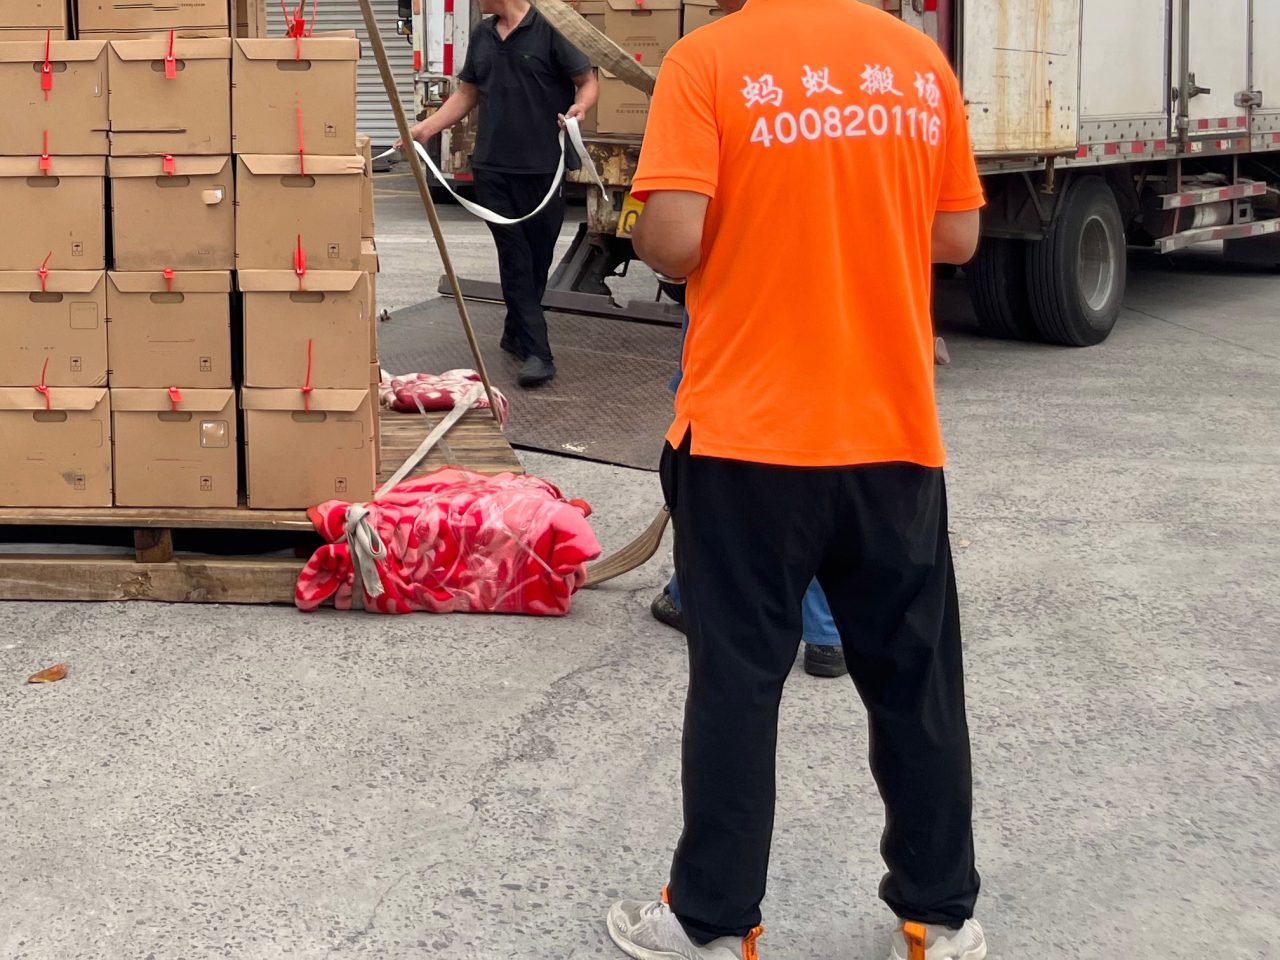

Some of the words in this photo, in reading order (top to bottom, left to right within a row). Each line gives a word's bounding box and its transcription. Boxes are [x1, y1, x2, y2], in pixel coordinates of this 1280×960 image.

[740, 64, 941, 109] 蚂蚁搬场
[750, 104, 942, 148] 4008201116
